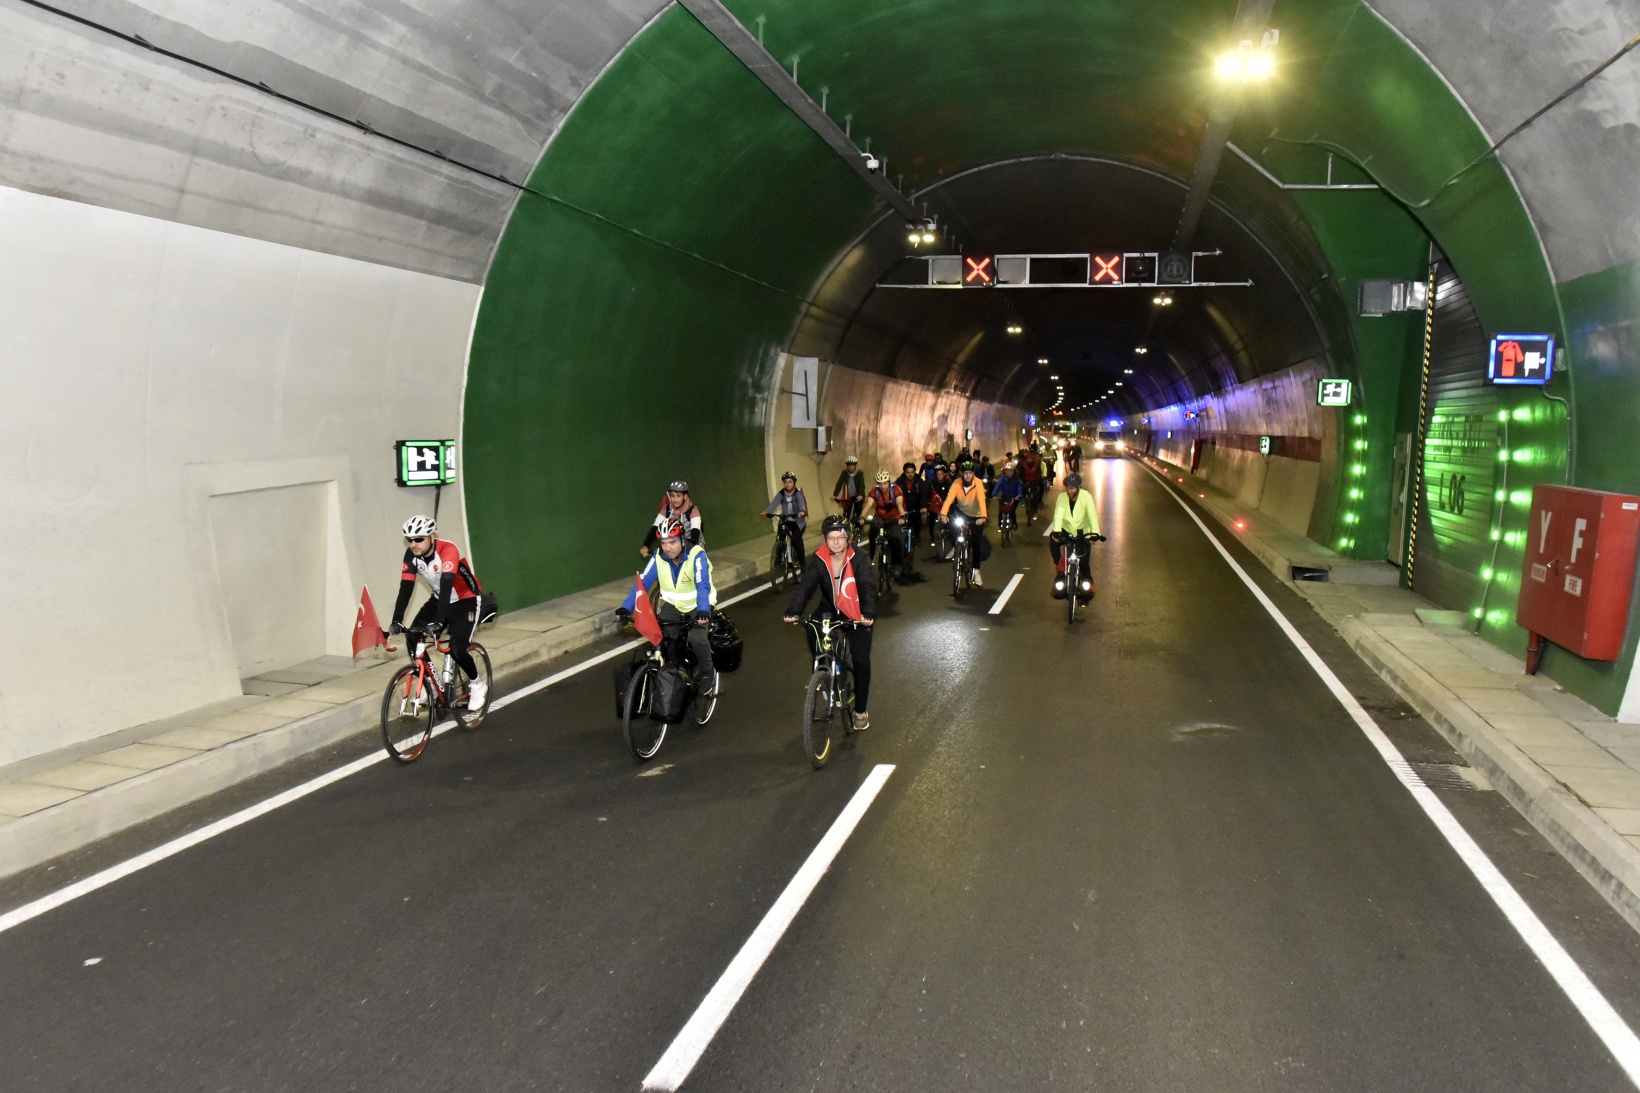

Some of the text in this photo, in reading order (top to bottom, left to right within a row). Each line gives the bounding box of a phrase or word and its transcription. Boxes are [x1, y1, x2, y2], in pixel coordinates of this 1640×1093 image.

[1439, 472, 1466, 515] L06
[1539, 510, 1587, 564] Y F
